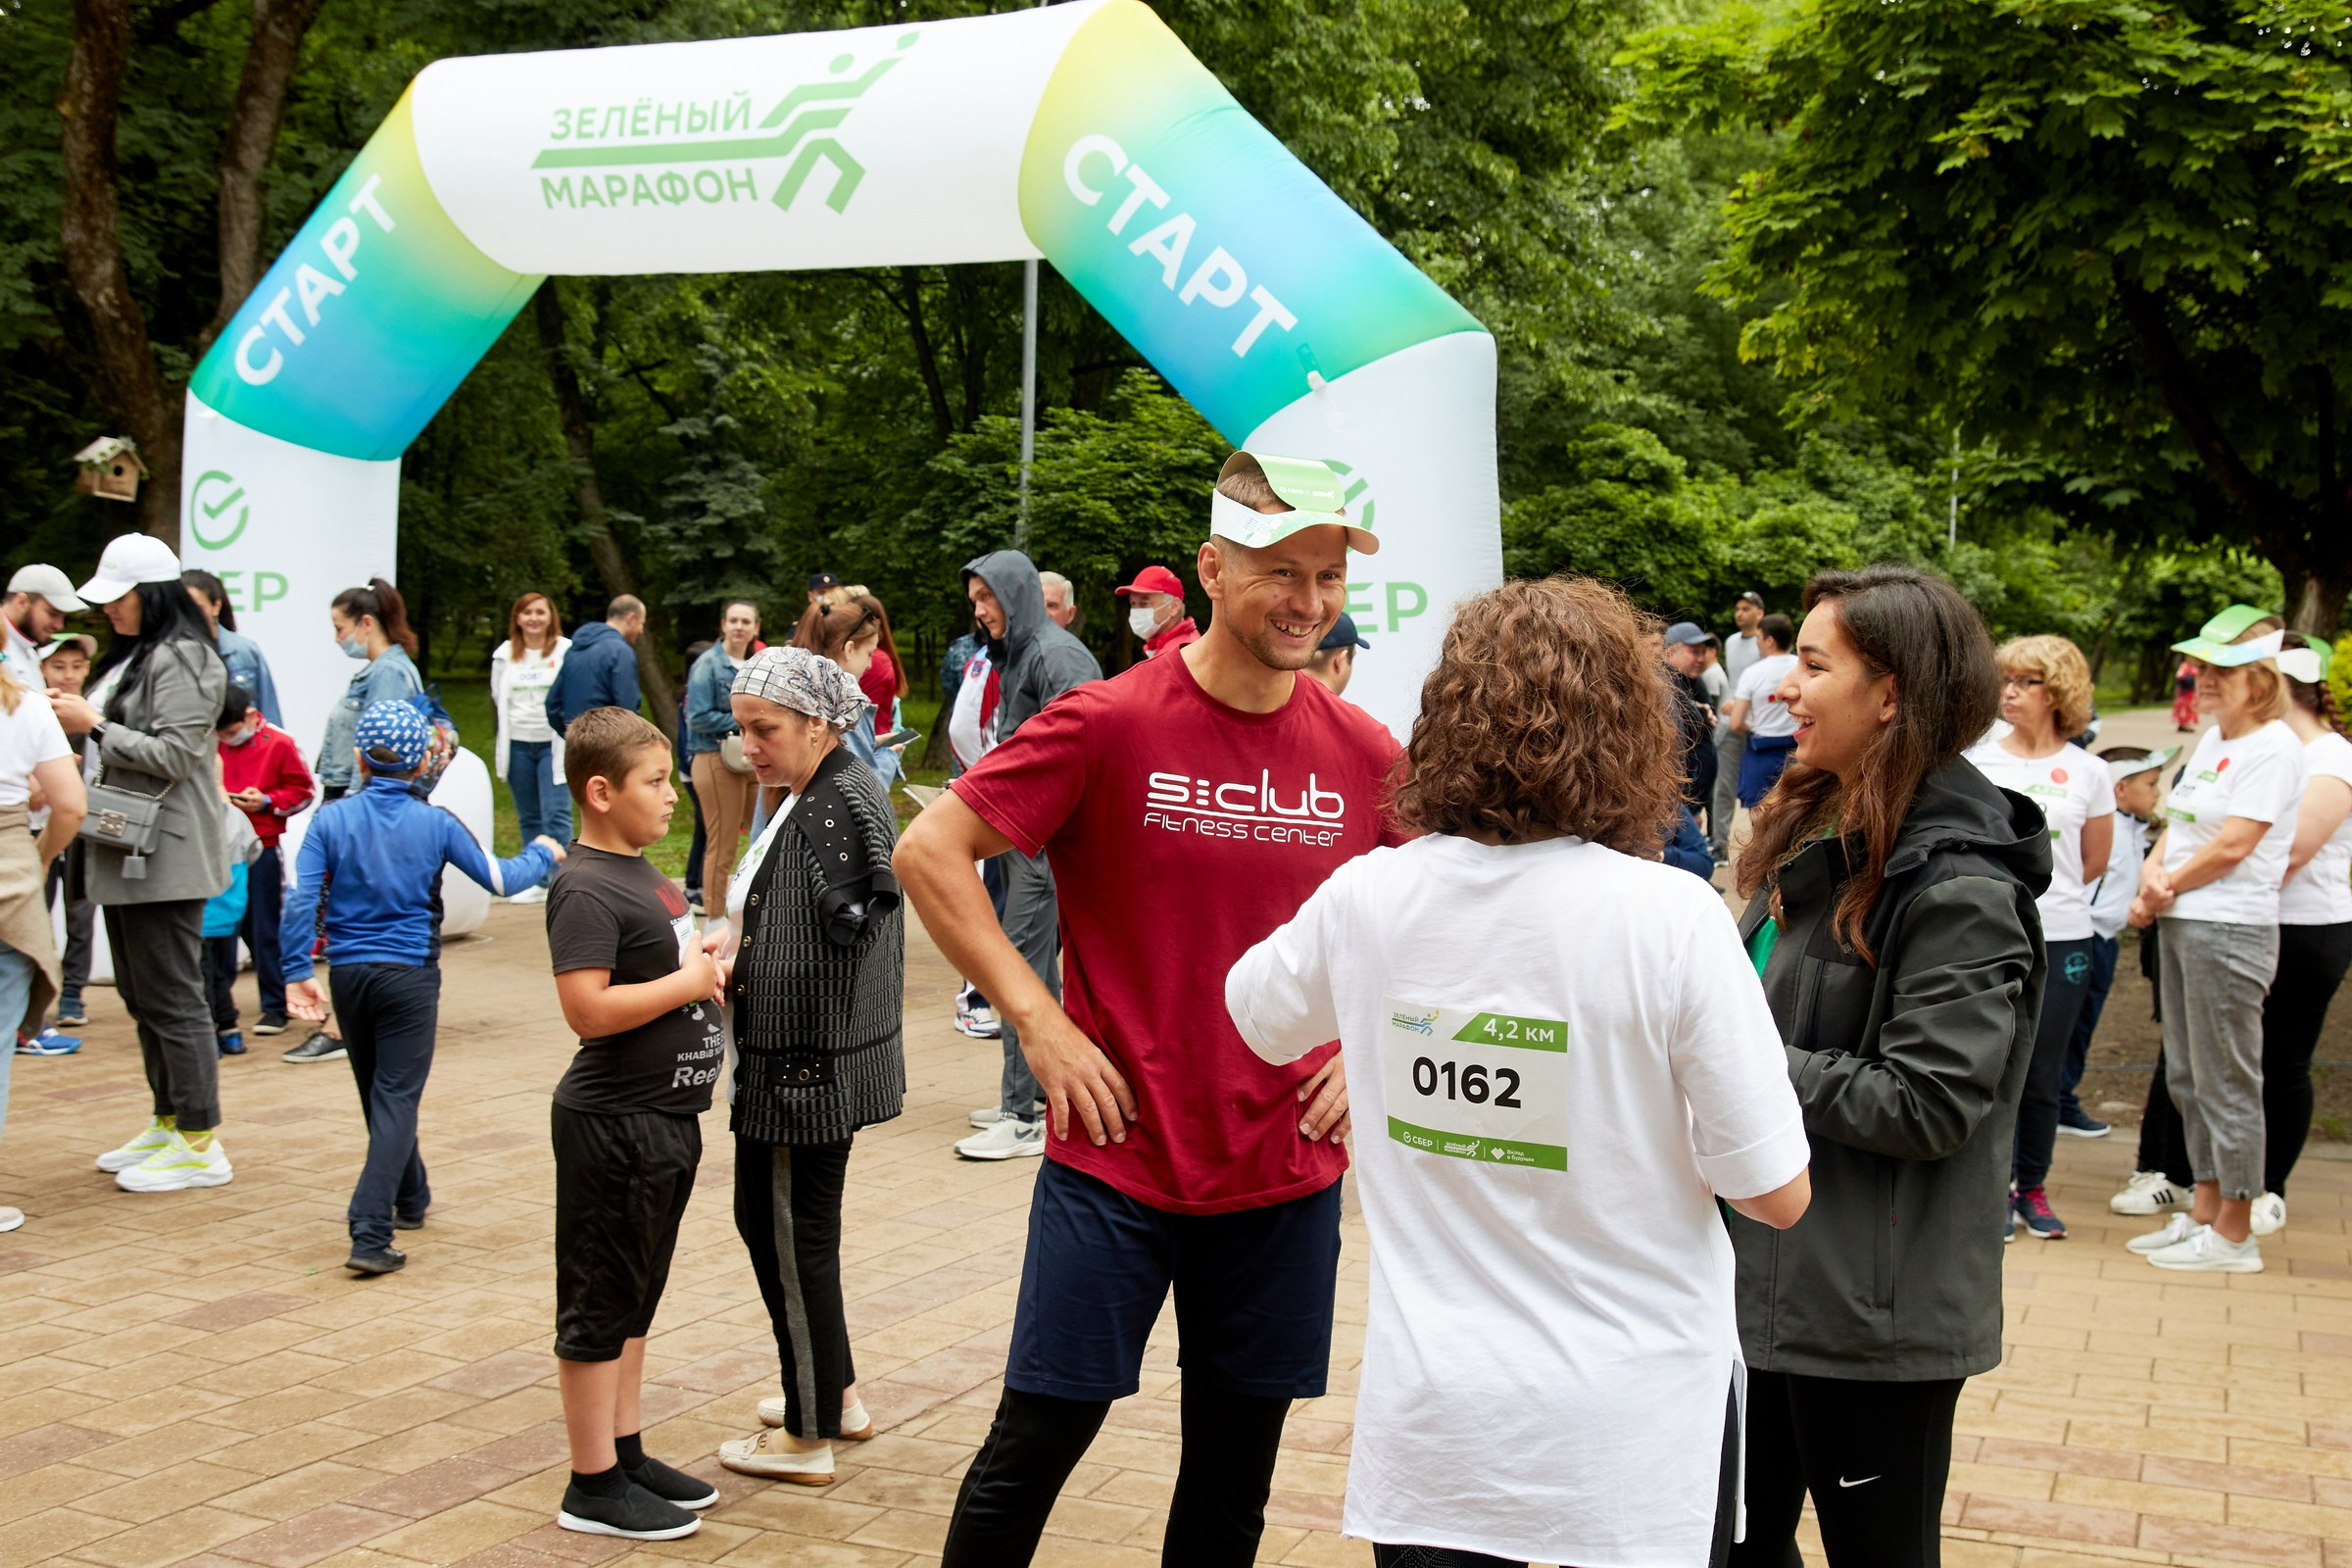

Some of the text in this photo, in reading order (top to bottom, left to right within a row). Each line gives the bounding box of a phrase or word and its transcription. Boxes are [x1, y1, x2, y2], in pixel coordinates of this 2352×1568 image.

[550, 91, 752, 141] ЗЕЛЁНЫЙ
[540, 168, 759, 210] МАРАФОН
[1063, 134, 1298, 358] СТАРТ
[234, 172, 397, 386] СТАРТ
[219, 570, 289, 612] ЕР
[1346, 581, 1428, 633] ЕР
[1392, 1021, 1419, 1033] МАРАФОН
[1393, 1011, 1419, 1023] ЗЕЛЁНЫЙ
[1483, 1018, 1518, 1041] 4,2
[1413, 1056, 1521, 1108] 0162
[1412, 1135, 1433, 1148] СБЕР
[1511, 1154, 1535, 1163] будущее
